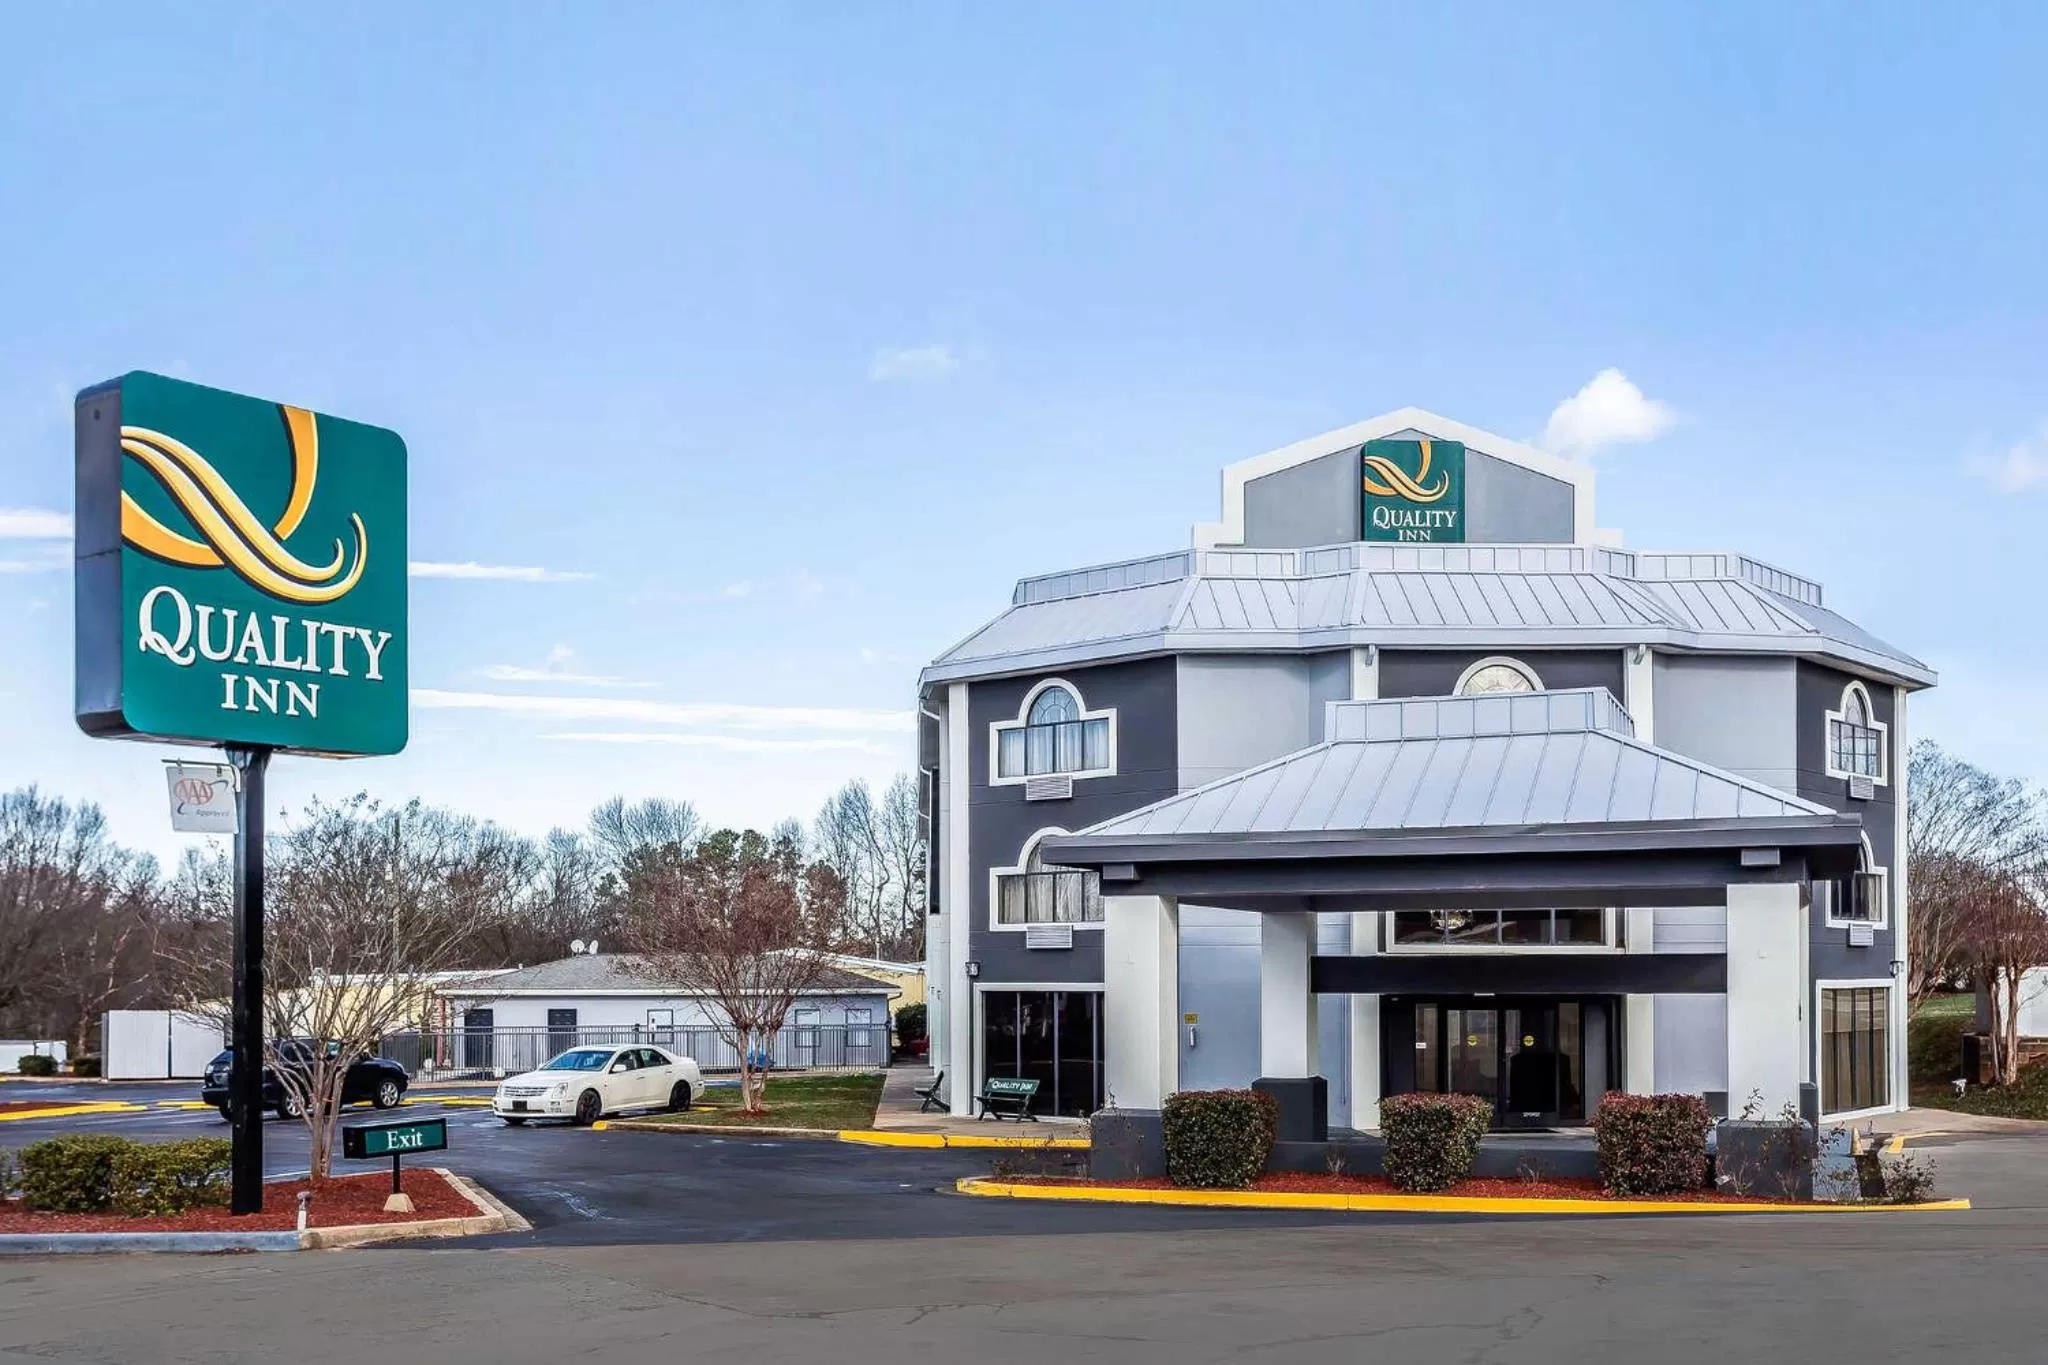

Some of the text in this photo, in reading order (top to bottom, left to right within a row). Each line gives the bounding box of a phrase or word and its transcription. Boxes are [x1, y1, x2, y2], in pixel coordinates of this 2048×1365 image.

[1373, 506, 1457, 529] QUALITY
[1398, 530, 1431, 541] INN
[139, 585, 392, 681] QUALITY
[221, 674, 320, 718] INN
[177, 779, 211, 804] AAA
[386, 1128, 423, 1150] Exit
